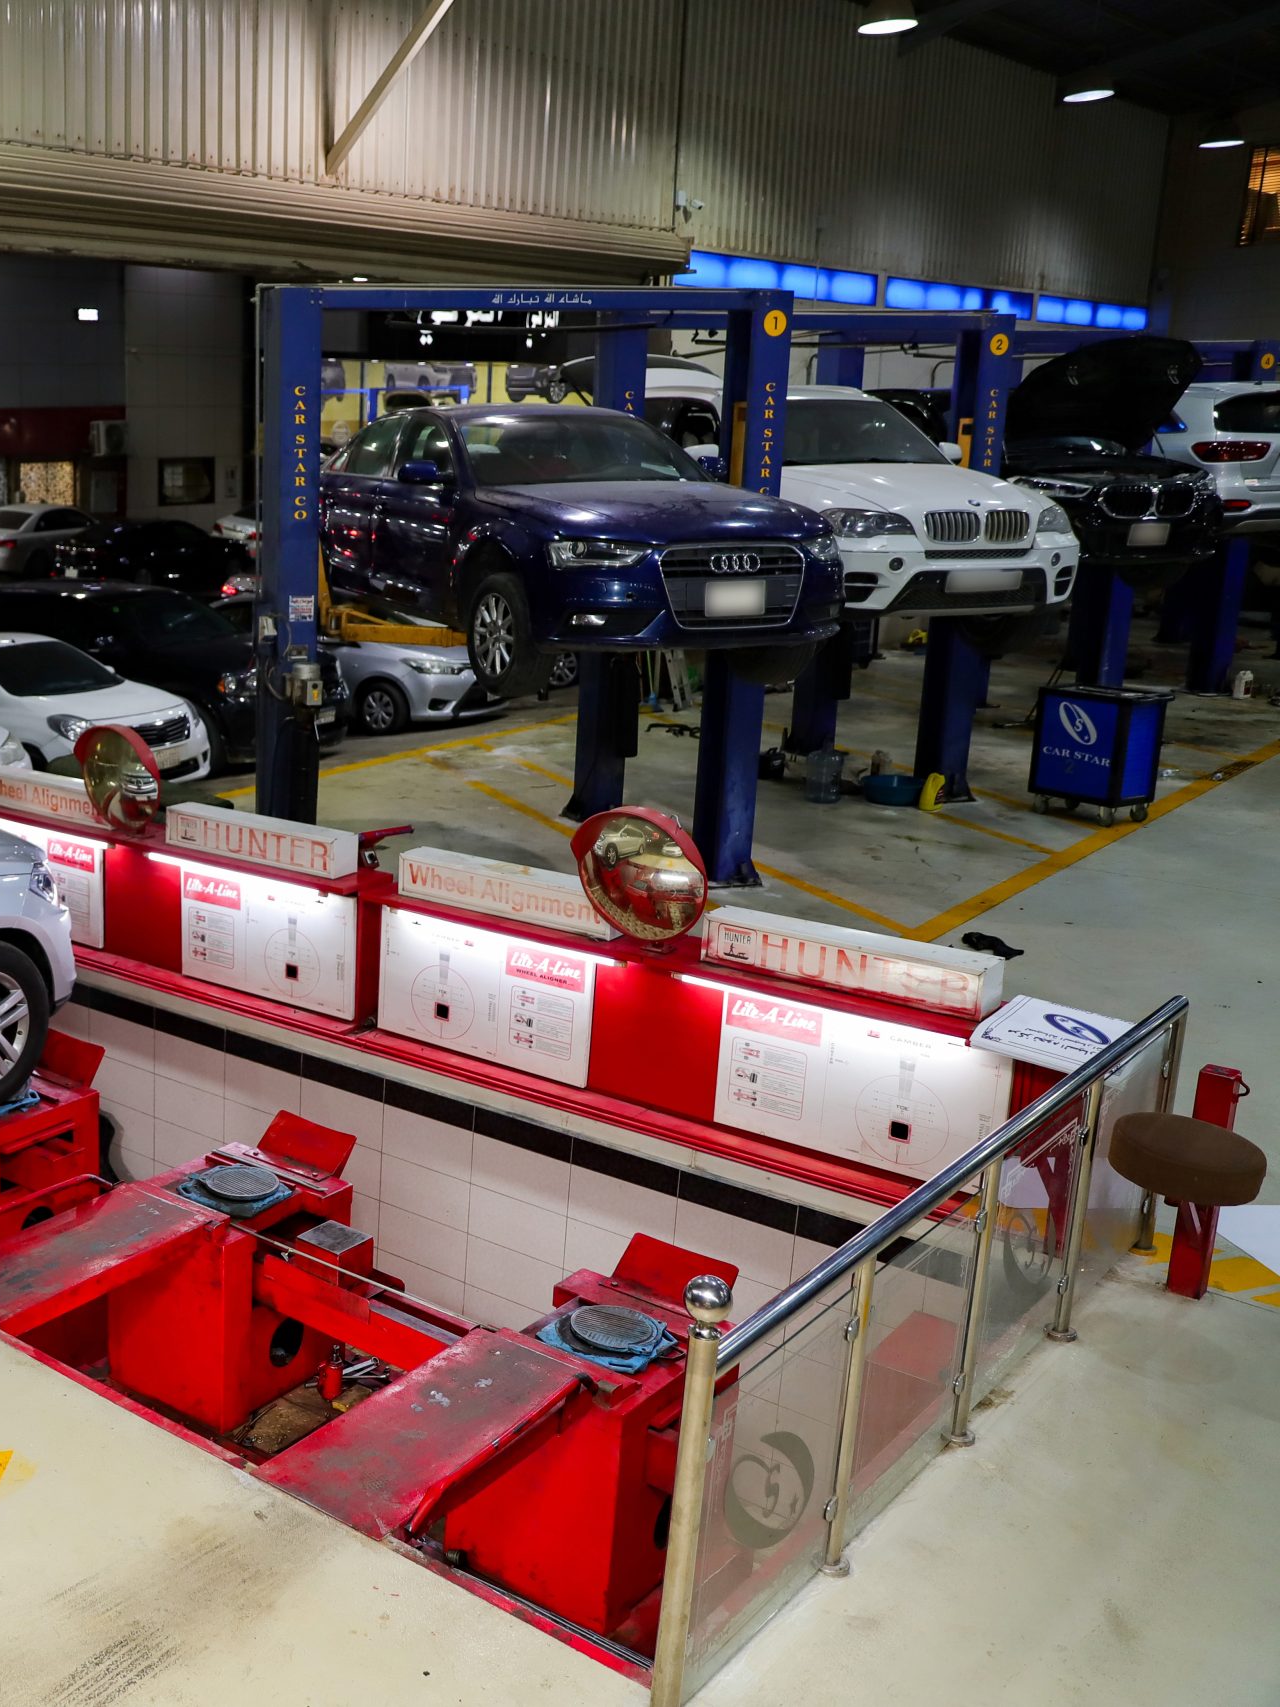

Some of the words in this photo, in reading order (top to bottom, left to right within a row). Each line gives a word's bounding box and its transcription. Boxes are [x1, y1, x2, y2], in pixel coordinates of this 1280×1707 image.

[995, 338, 1003, 351] 2
[293, 385, 307, 425] CAR
[624, 390, 635, 411] CA
[763, 382, 776, 419] CAR
[987, 388, 999, 419] CAR
[293, 433, 308, 488] STAR
[760, 427, 774, 478] STAR
[983, 426, 995, 467] STAR
[293, 495, 309, 520] CO
[1042, 745, 1071, 758] CAR
[1073, 751, 1112, 768] STAR
[31, 786, 99, 817] Alignme
[203, 820, 330, 872] HUNTER
[408, 862, 475, 898] Wheel
[480, 878, 601, 925] Alignment
[723, 930, 752, 945] HUNTER
[515, 968, 538, 979] WHEEL
[539, 974, 568, 986] ALIGNER
[1060, 1042, 1098, 1056] السيار
